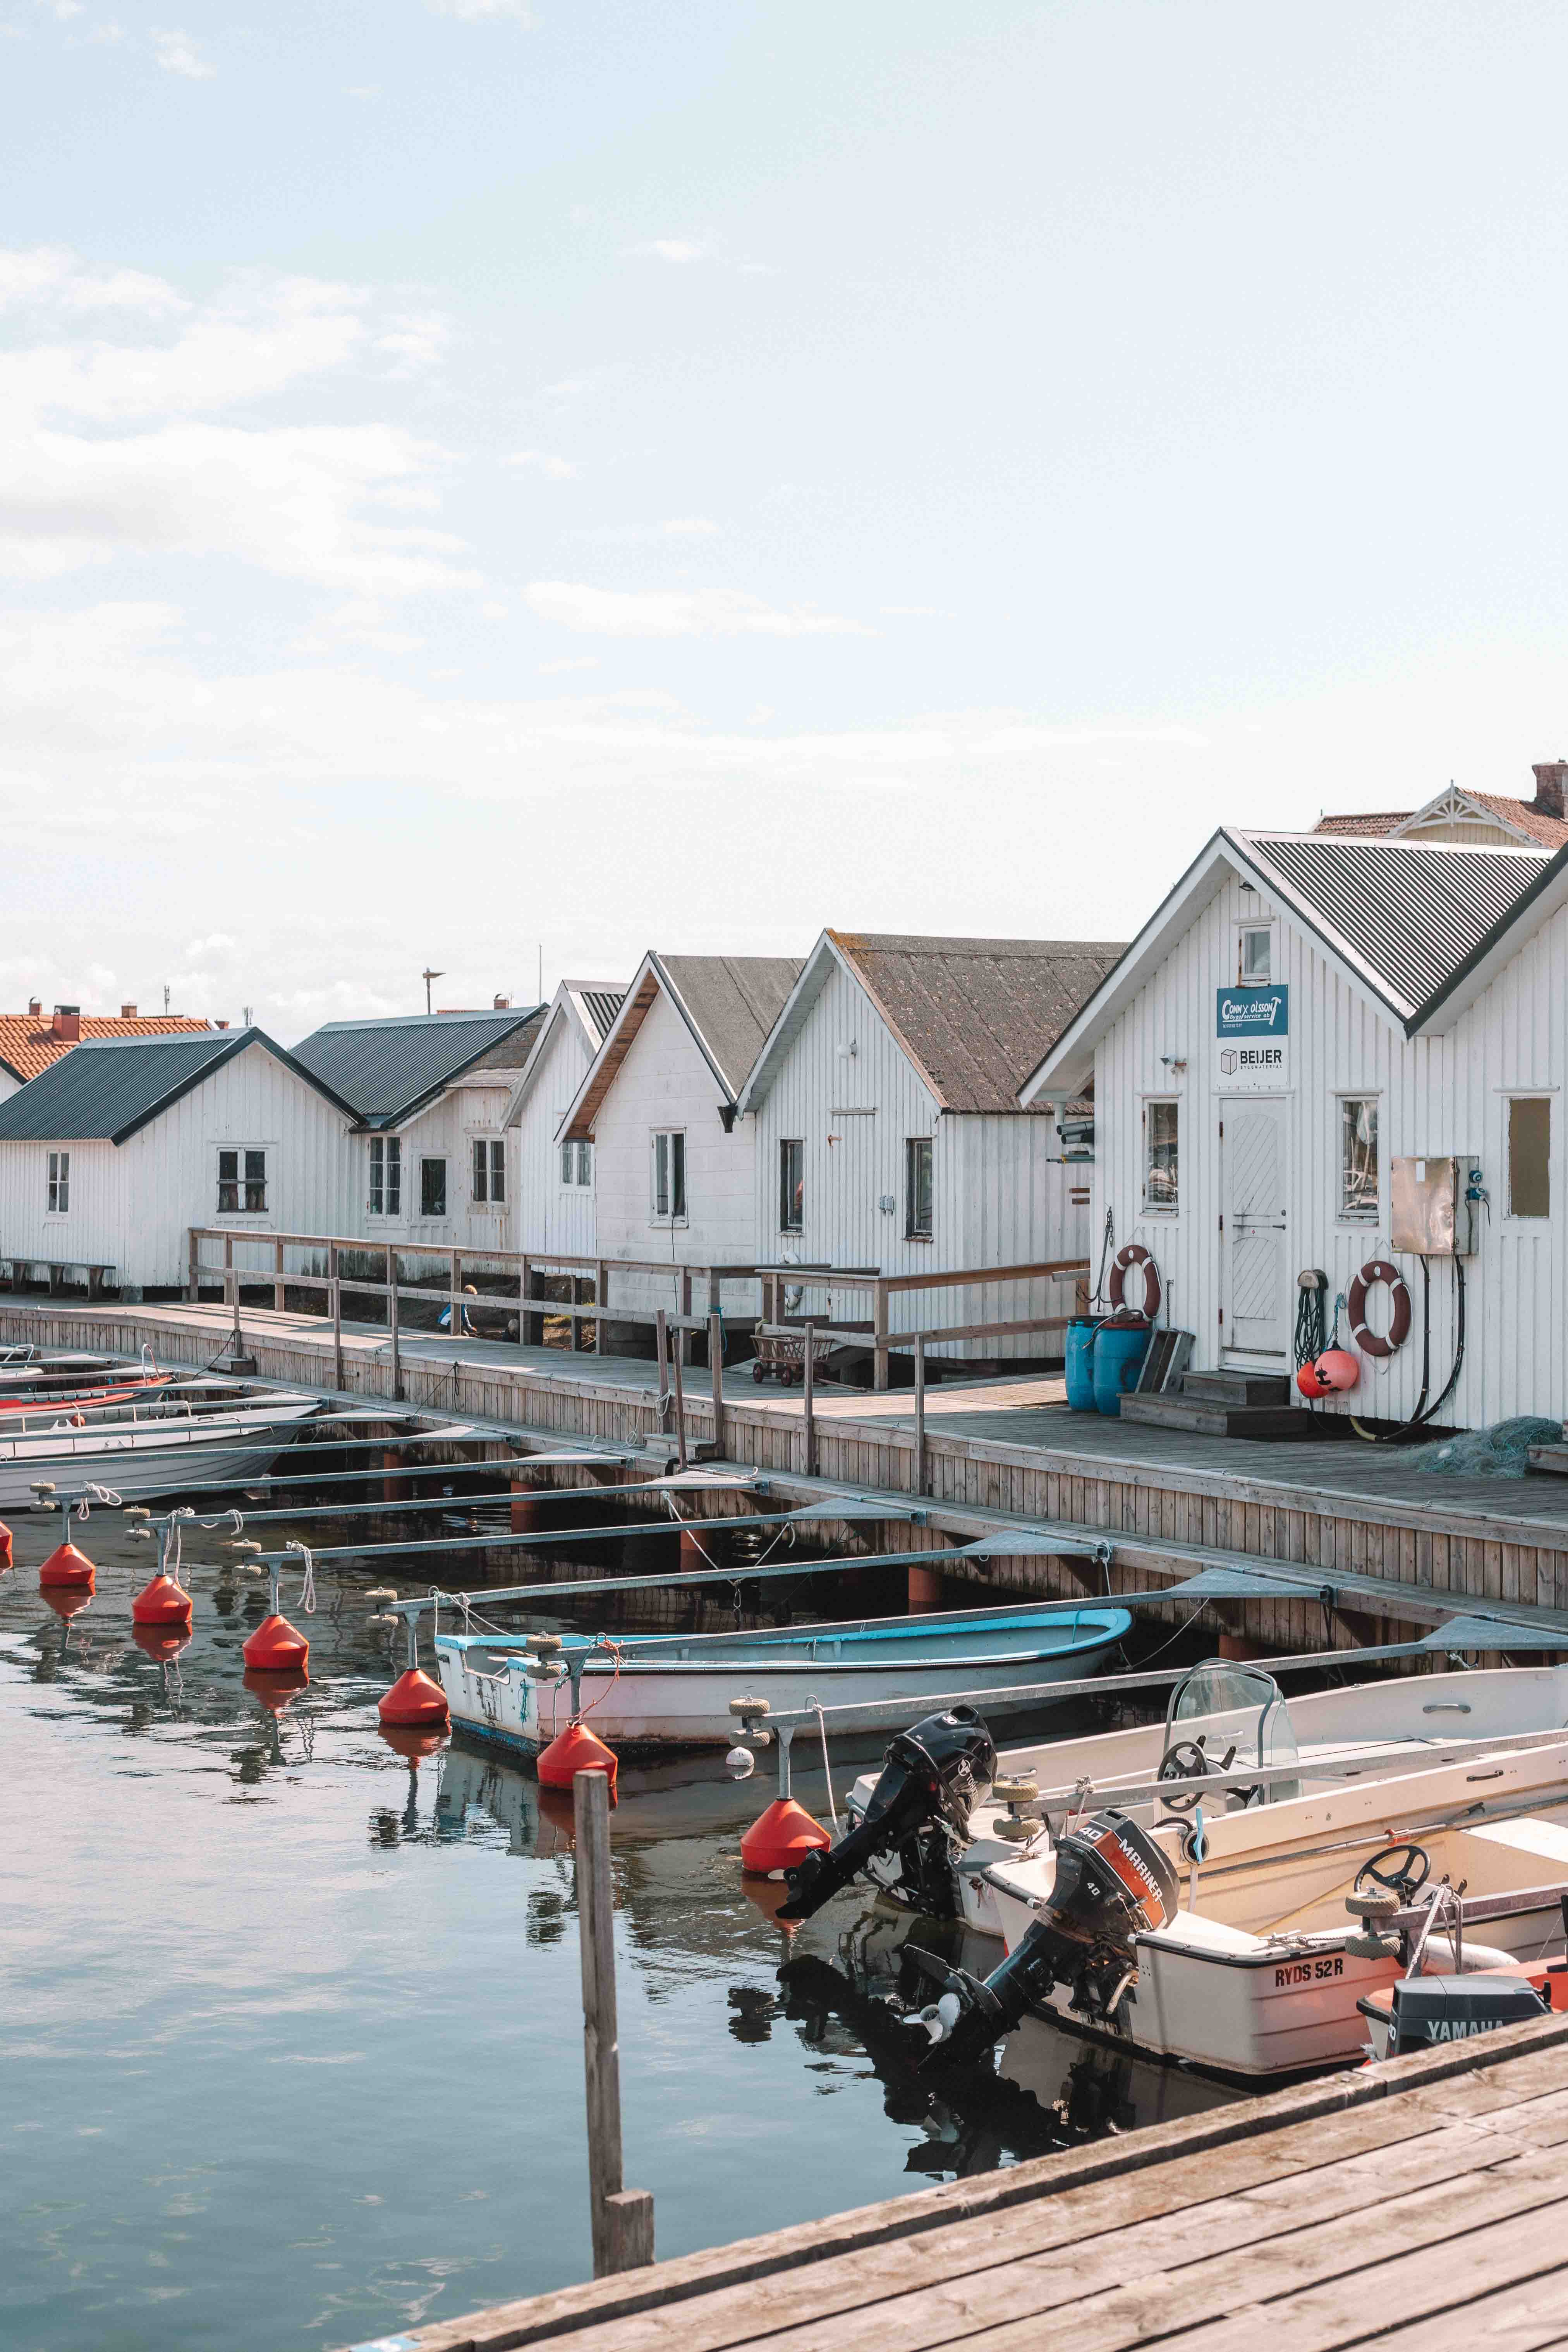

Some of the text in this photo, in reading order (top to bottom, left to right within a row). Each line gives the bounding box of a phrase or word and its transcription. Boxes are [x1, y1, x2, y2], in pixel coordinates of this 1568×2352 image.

[1240, 1050, 1282, 1064] BEIJER
[943, 1716, 958, 1724] 30
[1079, 1827, 1103, 1840] 40
[1118, 1839, 1163, 1902] MARINER
[1087, 1882, 1100, 1896] 40
[1275, 1964, 1311, 1987] RYDS
